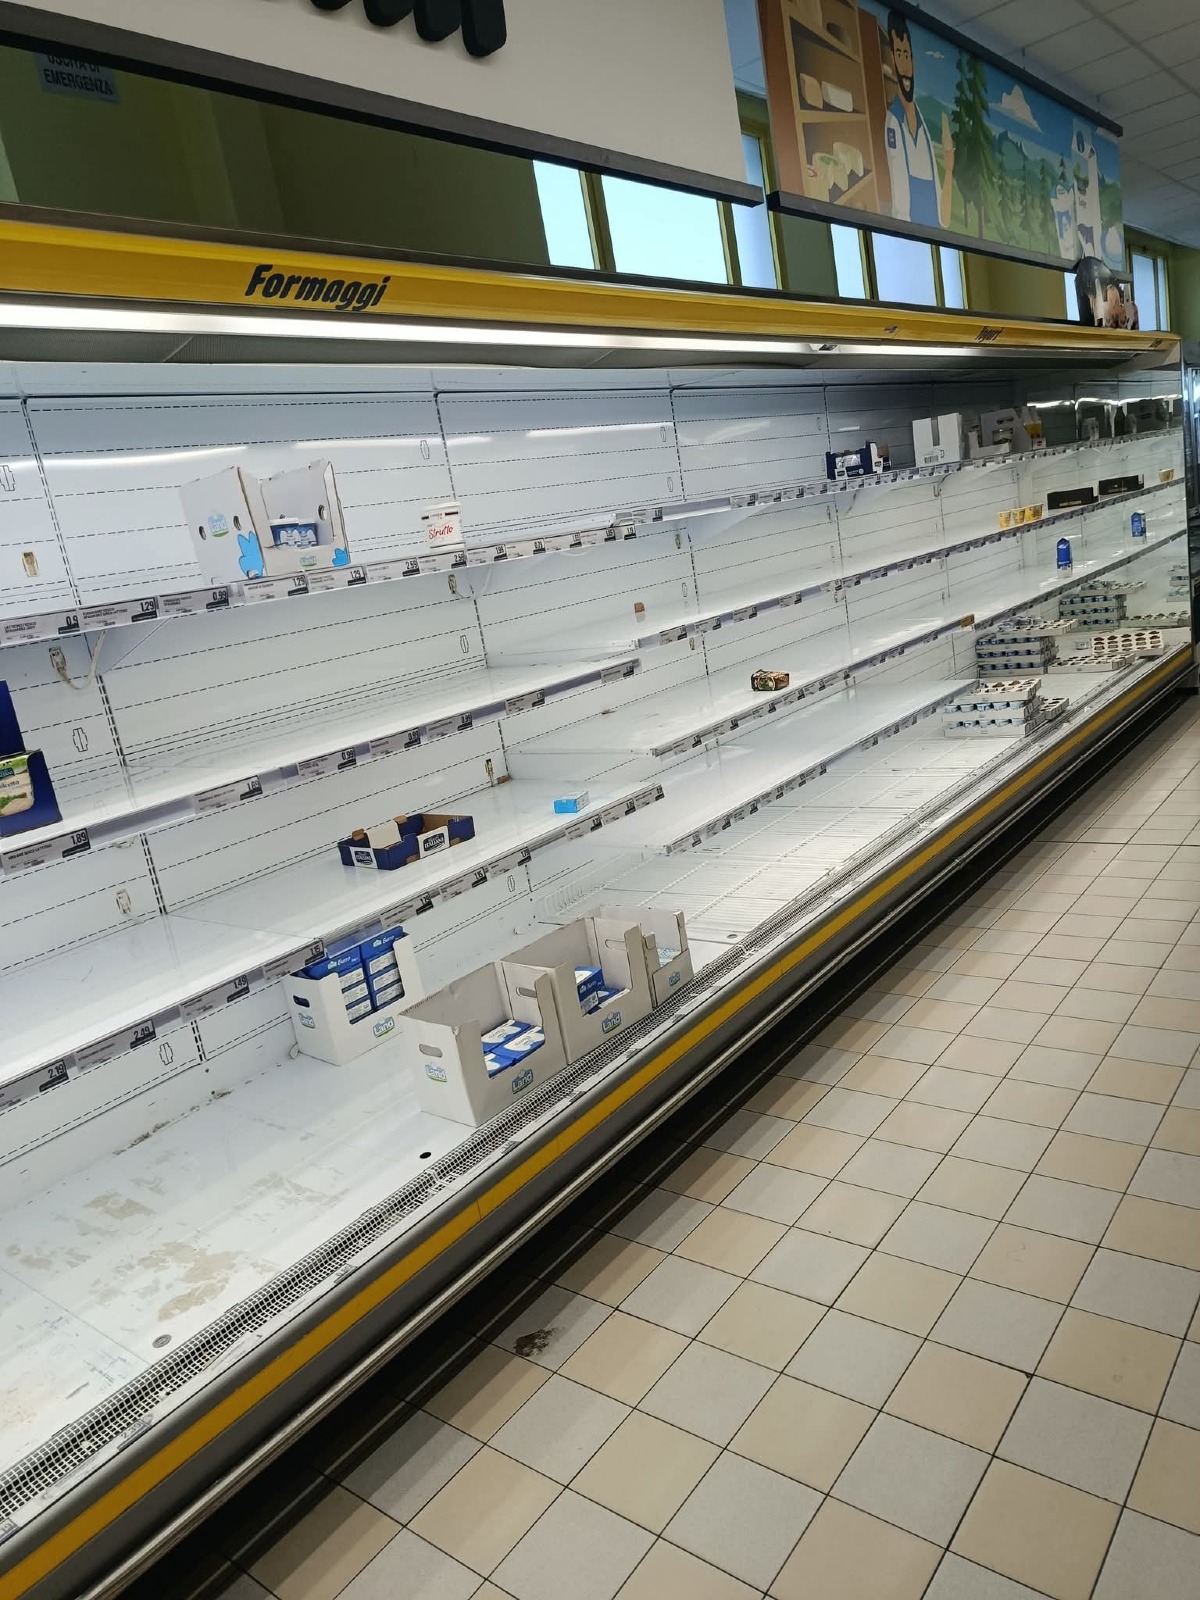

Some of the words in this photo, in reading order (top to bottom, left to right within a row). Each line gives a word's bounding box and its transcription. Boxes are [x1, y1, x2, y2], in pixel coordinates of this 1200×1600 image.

[43, 68, 114, 96] EMERGENZA
[244, 263, 392, 312] Formaggi
[428, 524, 454, 540] Strutto
[70, 831, 87, 845] 1.89
[373, 1017, 395, 1035] Land
[602, 1014, 621, 1032] Land
[133, 1025, 151, 1041] 2.49
[47, 1063, 66, 1078] 2.19
[512, 1073, 534, 1091] Land
